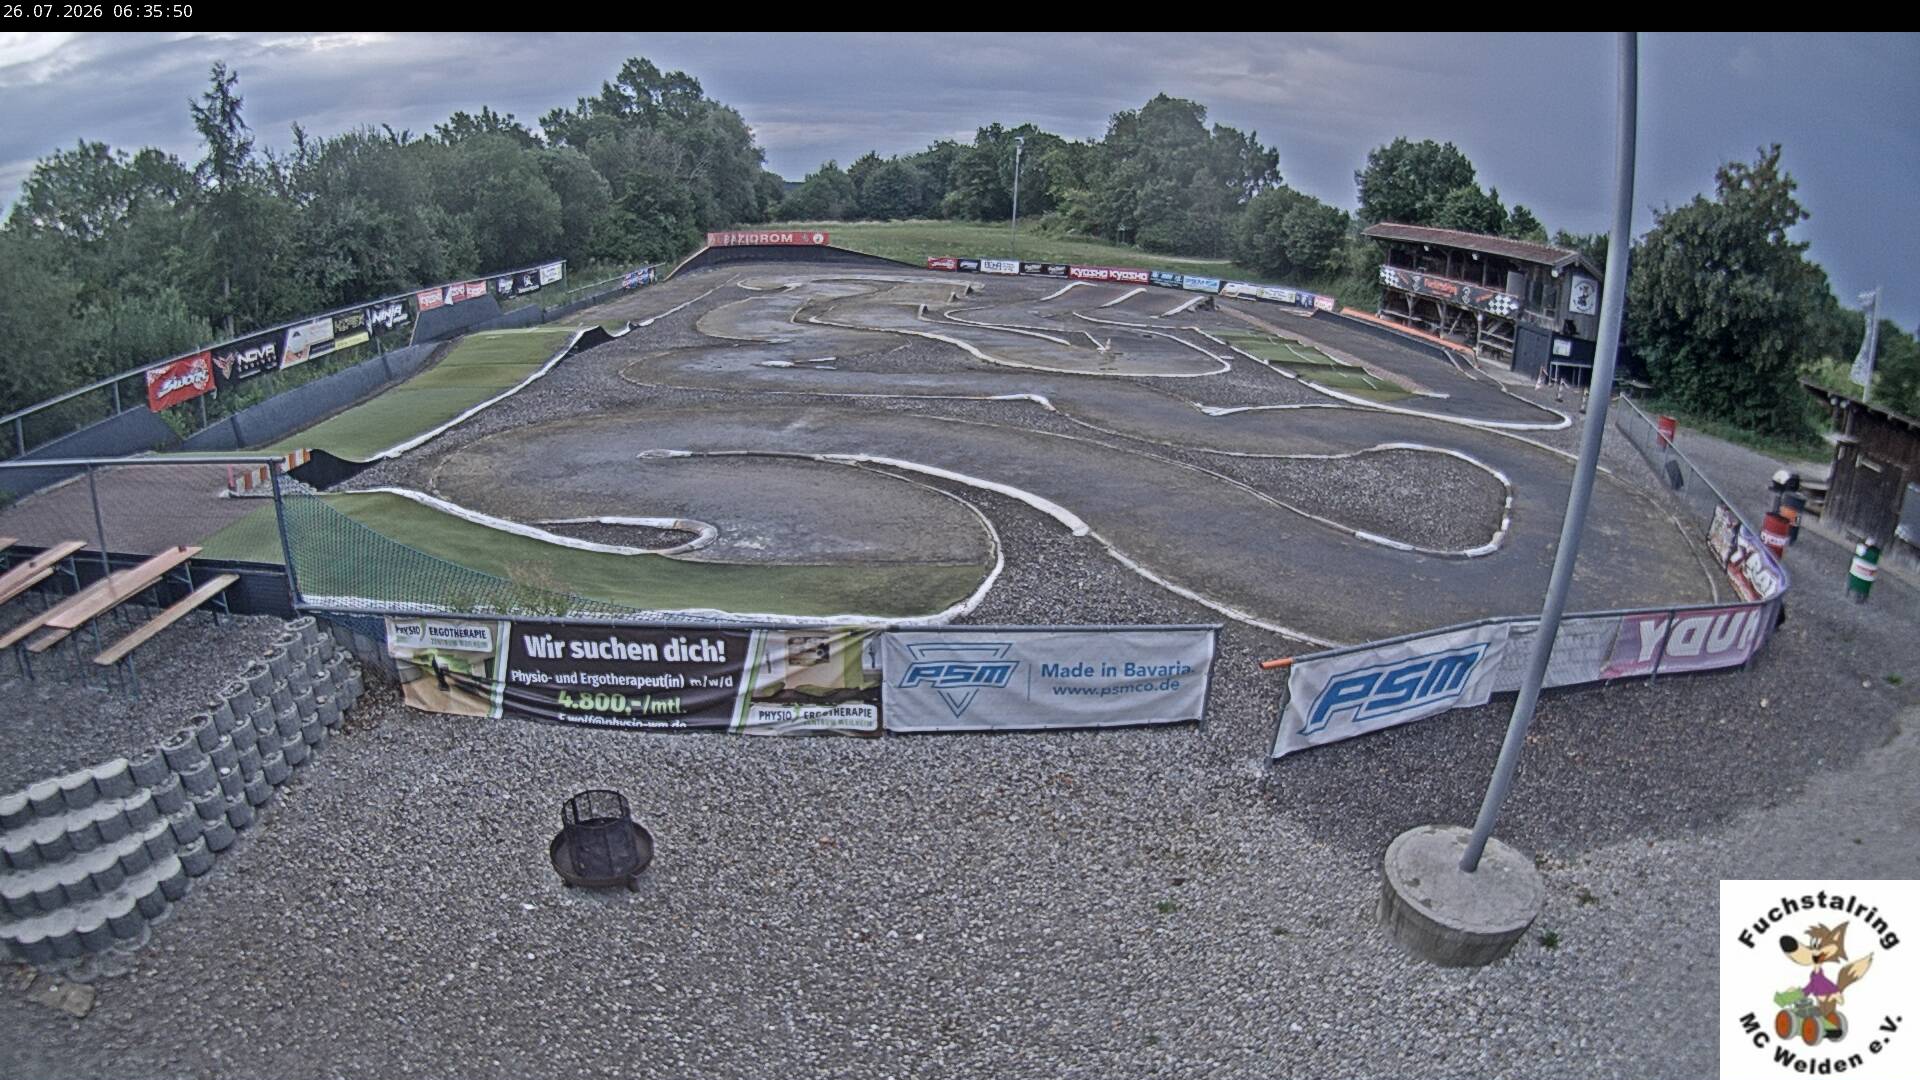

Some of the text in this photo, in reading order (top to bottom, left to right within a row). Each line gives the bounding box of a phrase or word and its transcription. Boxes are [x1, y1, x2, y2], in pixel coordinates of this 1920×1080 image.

[238, 344, 277, 364] NOVA
[395, 624, 488, 639] PHYSIO ERGOTHERAPIE
[523, 634, 726, 663] Wir suchen dich!
[511, 670, 733, 688] Physio- und Ergotherapeut(in) m/w/d
[902, 661, 1013, 688] PSM
[1041, 662, 1095, 678] Made
[1102, 661, 1117, 678] in
[1053, 678, 1180, 697] www.psmco.de
[1303, 648, 1484, 729] PSM
[758, 710, 793, 721] PHYSIO
